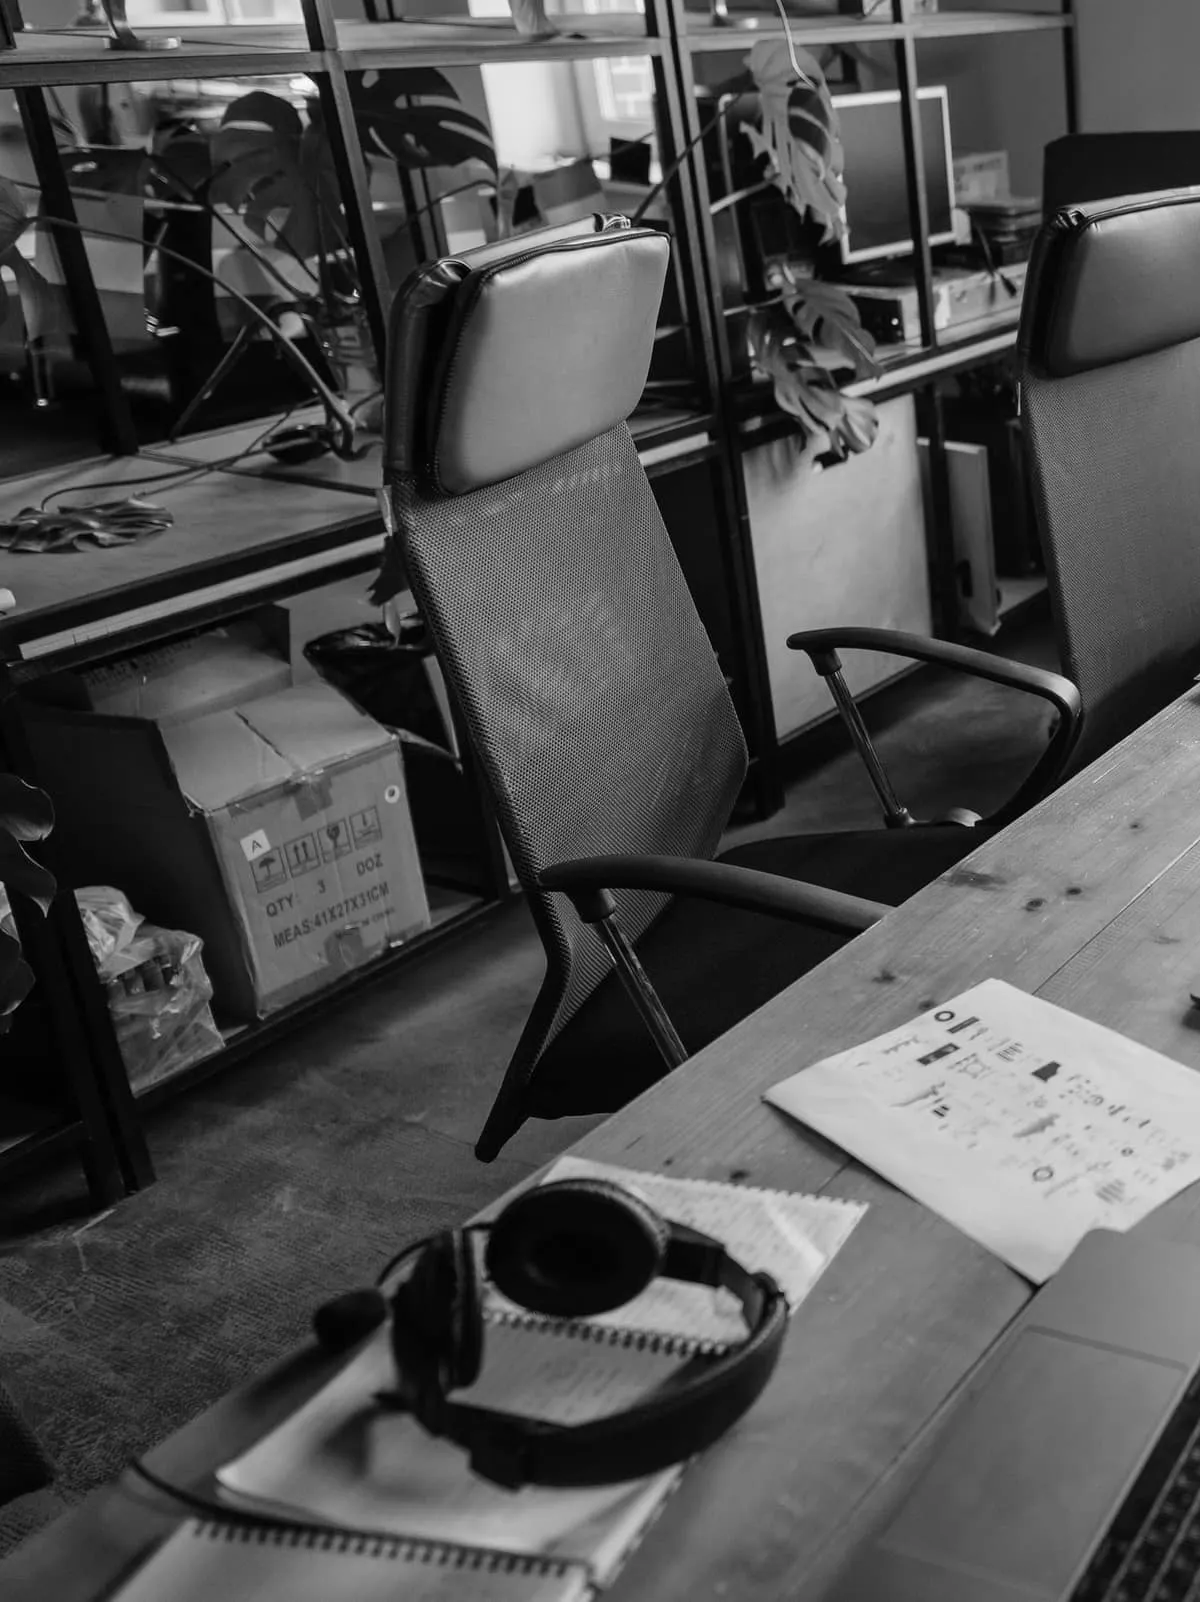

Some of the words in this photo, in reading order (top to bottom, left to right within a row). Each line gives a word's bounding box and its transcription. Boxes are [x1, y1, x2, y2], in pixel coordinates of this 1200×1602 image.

[251, 840, 263, 853] A
[317, 879, 327, 894] 3
[356, 853, 384, 877] DOZ
